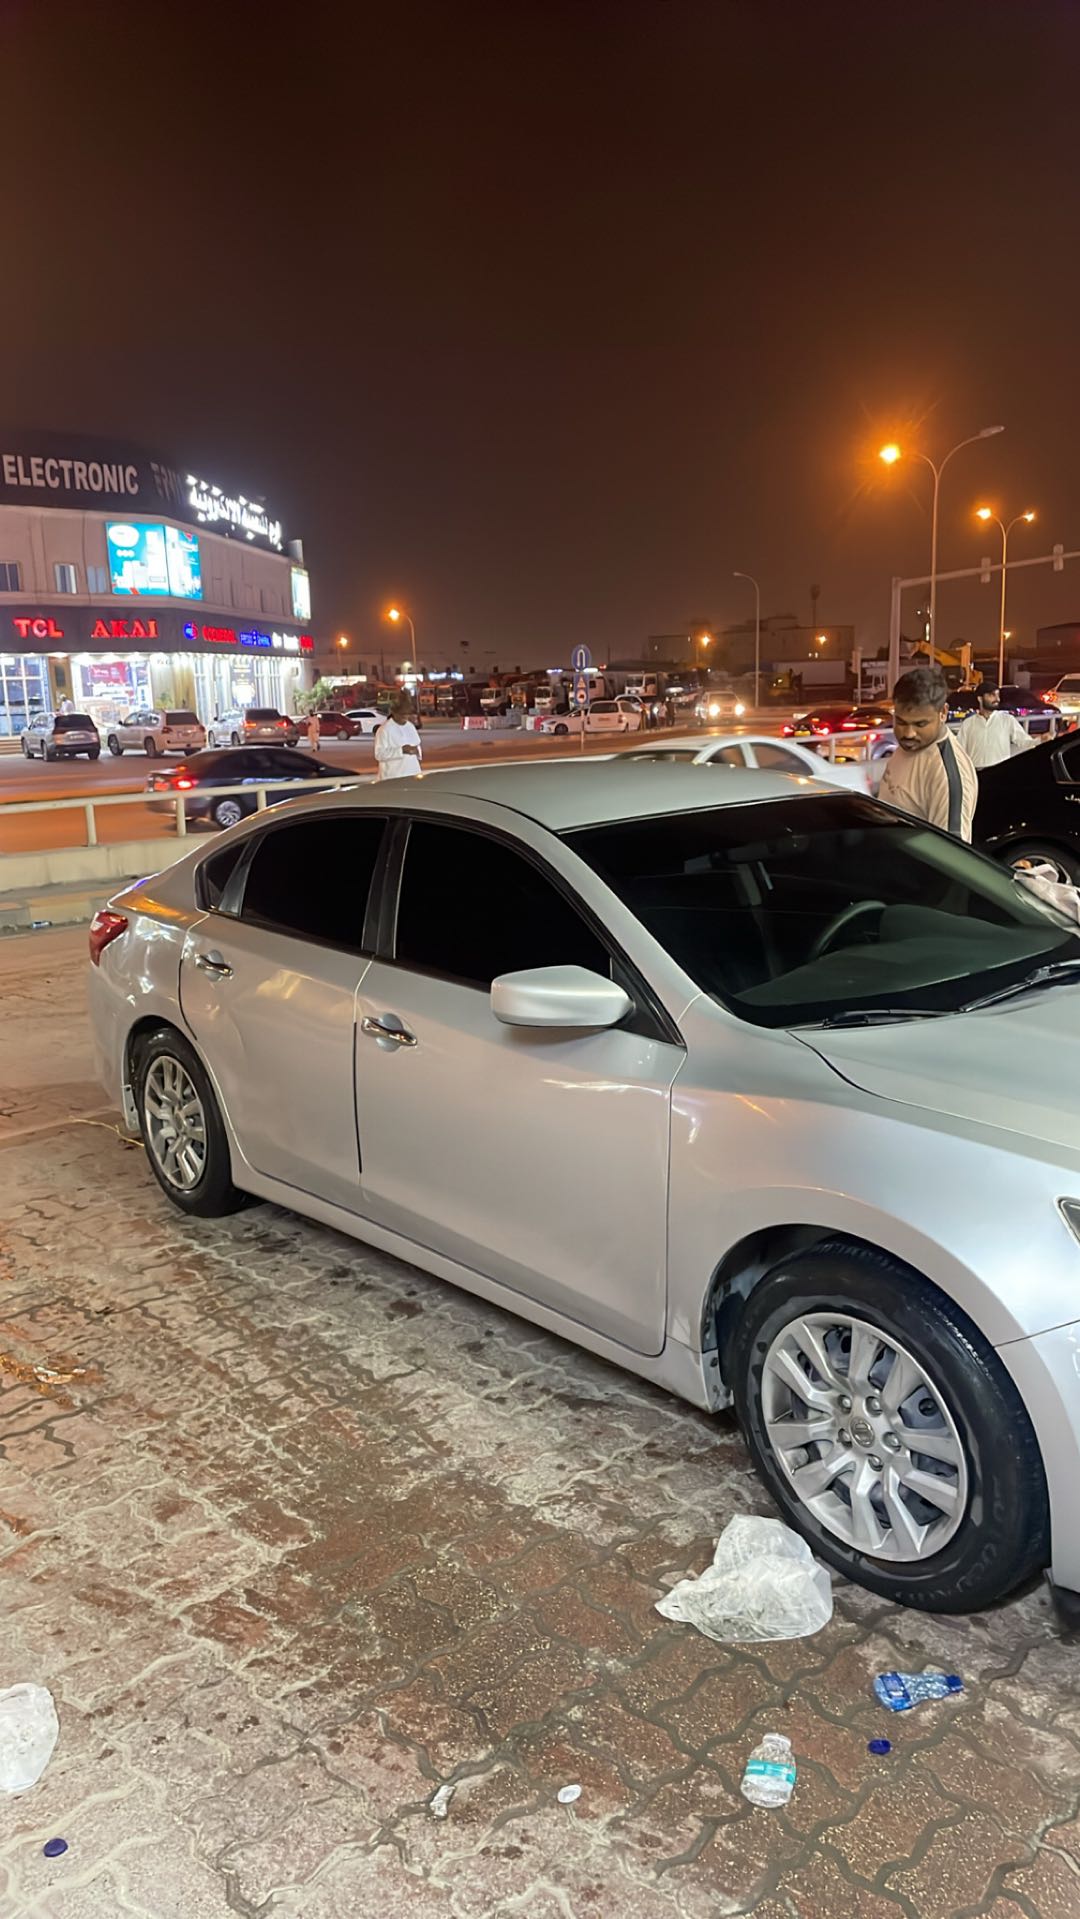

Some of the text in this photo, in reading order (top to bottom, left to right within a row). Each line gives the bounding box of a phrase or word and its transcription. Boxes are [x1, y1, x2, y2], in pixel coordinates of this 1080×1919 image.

[2, 454, 139, 495] ELECTRONIC
[13, 618, 63, 638] TCL
[91, 619, 158, 638] AKAI
